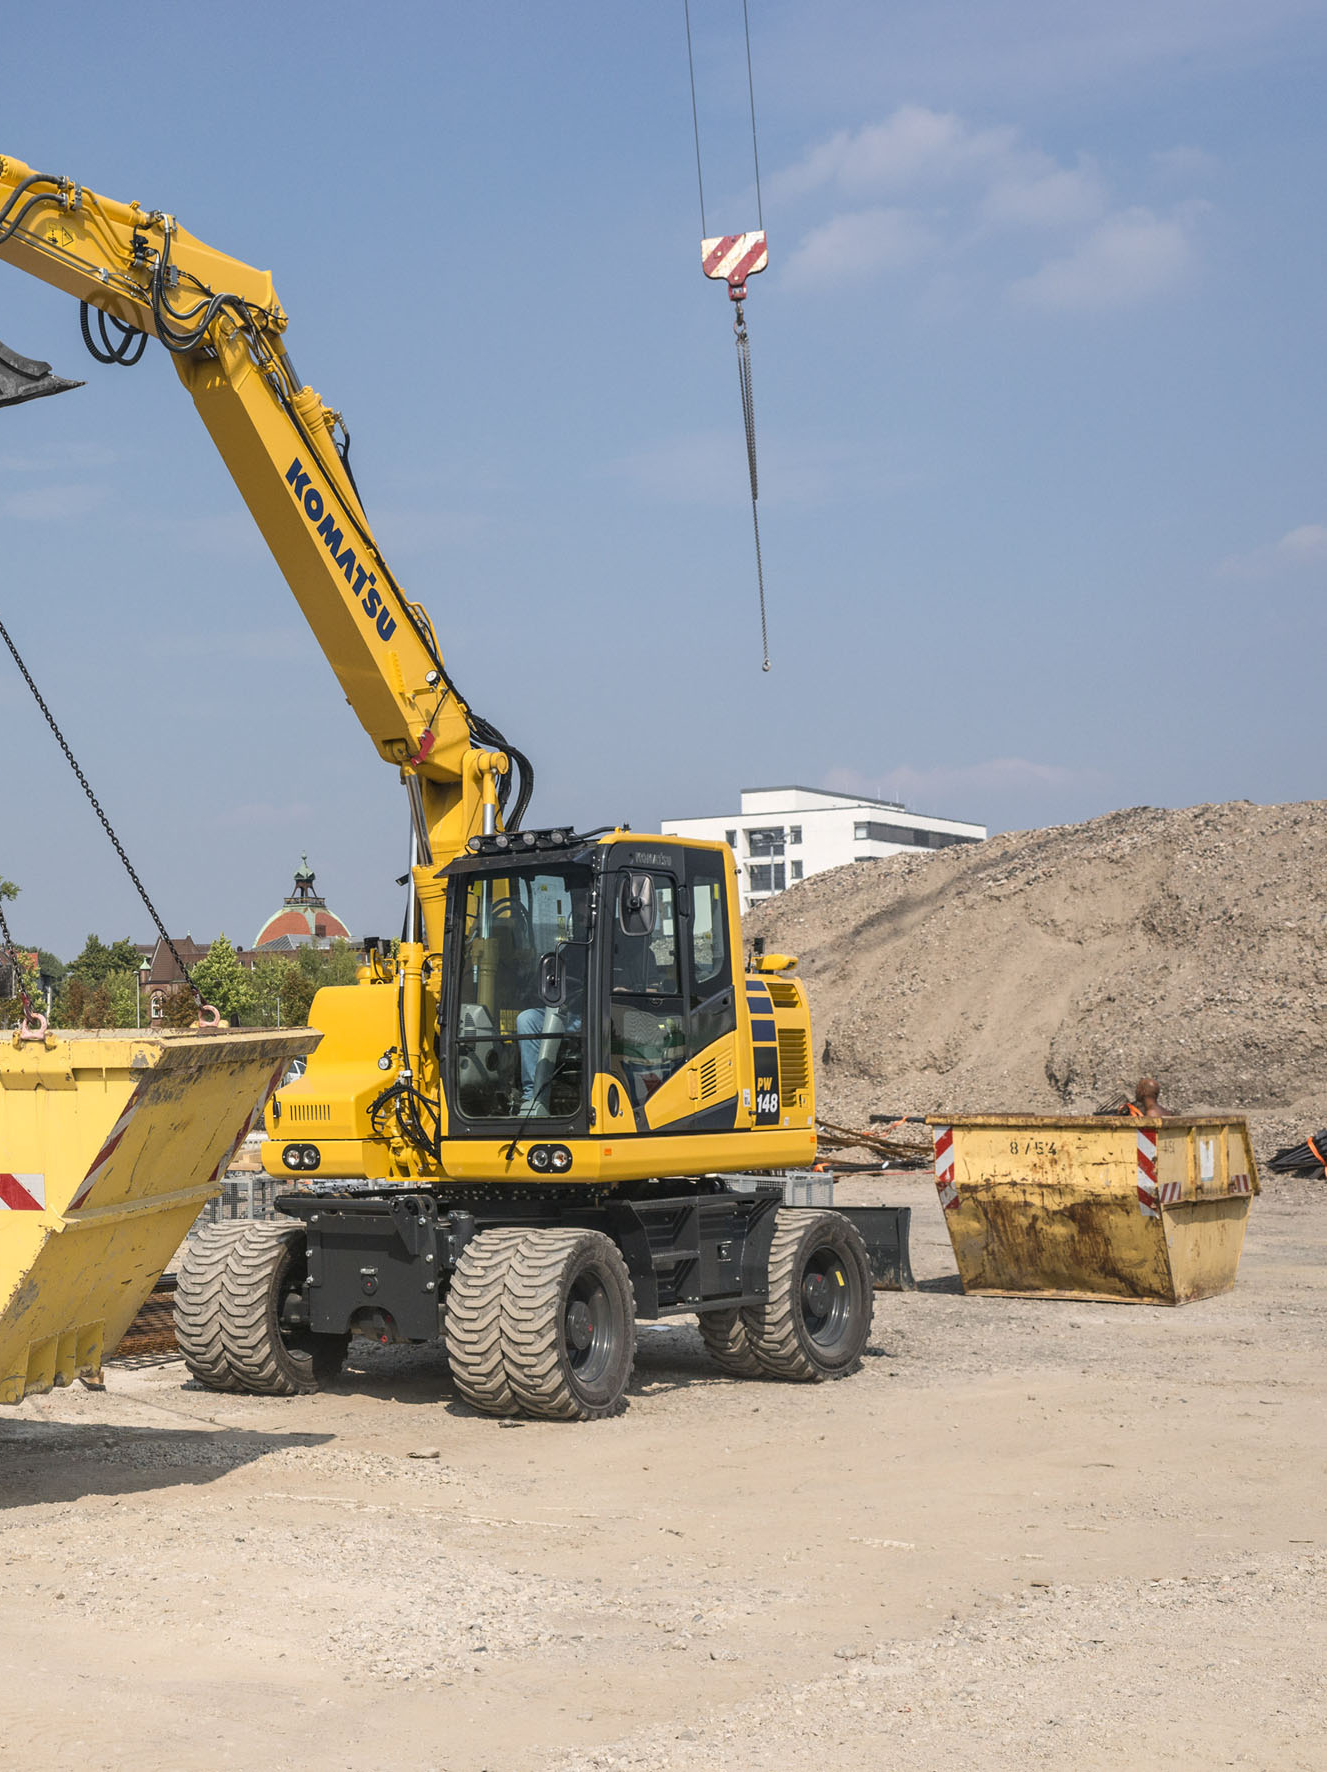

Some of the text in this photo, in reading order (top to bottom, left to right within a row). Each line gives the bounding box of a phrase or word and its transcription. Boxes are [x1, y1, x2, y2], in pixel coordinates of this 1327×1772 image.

[285, 457, 397, 641] KOMATSU
[757, 1077, 772, 1091] PW
[757, 1093, 778, 1113] 148
